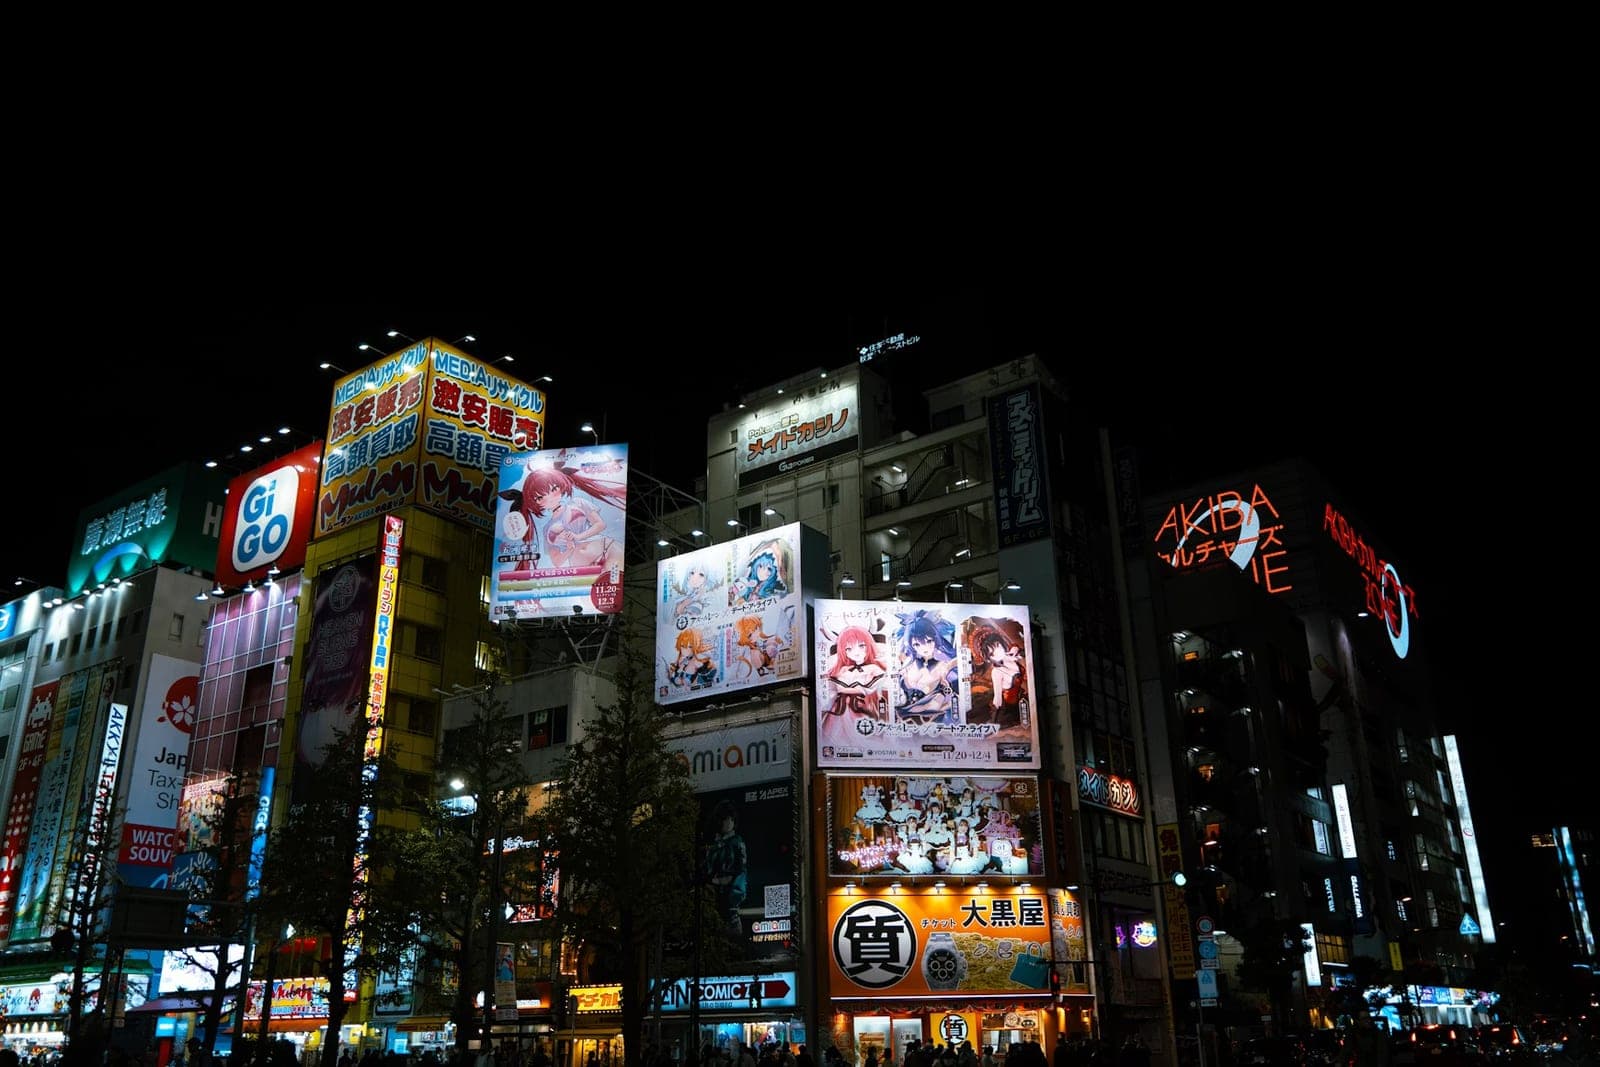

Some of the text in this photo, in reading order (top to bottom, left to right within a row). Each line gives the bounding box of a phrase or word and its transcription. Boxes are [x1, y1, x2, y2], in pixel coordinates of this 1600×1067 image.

[330, 371, 424, 444] 激安販売
[431, 377, 540, 449] 激安販売
[322, 412, 418, 486] 高額買取
[1153, 483, 1280, 543] AKIBA
[921, 898, 1046, 929] チケット 大黒屋
[844, 914, 910, 978] 質
[944, 1018, 965, 1041] 質
